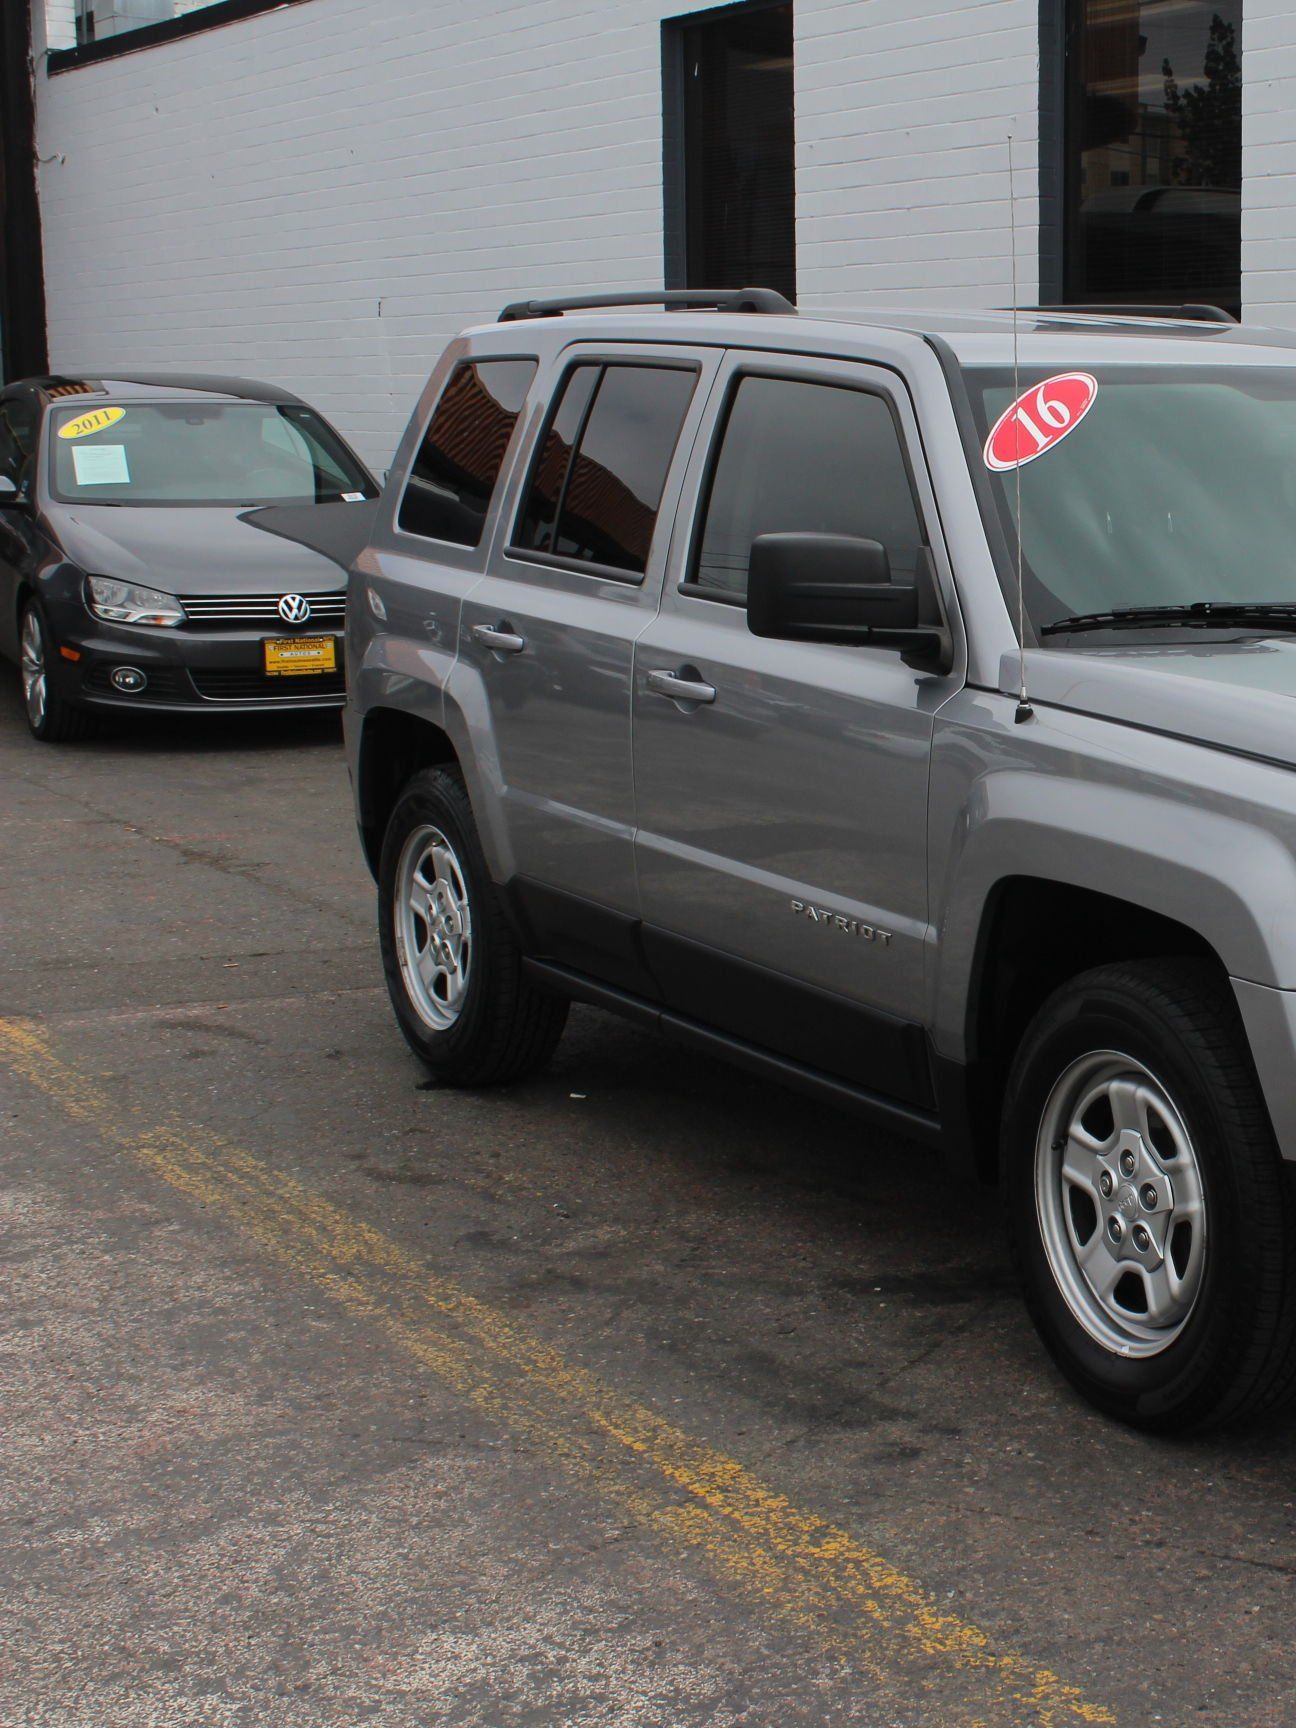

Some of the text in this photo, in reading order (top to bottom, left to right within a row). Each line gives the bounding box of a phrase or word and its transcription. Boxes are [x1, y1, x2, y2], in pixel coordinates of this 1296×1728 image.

[71, 411, 111, 435] 2011
[1011, 385, 1070, 451] 16
[791, 899, 893, 947] PATRIOT
